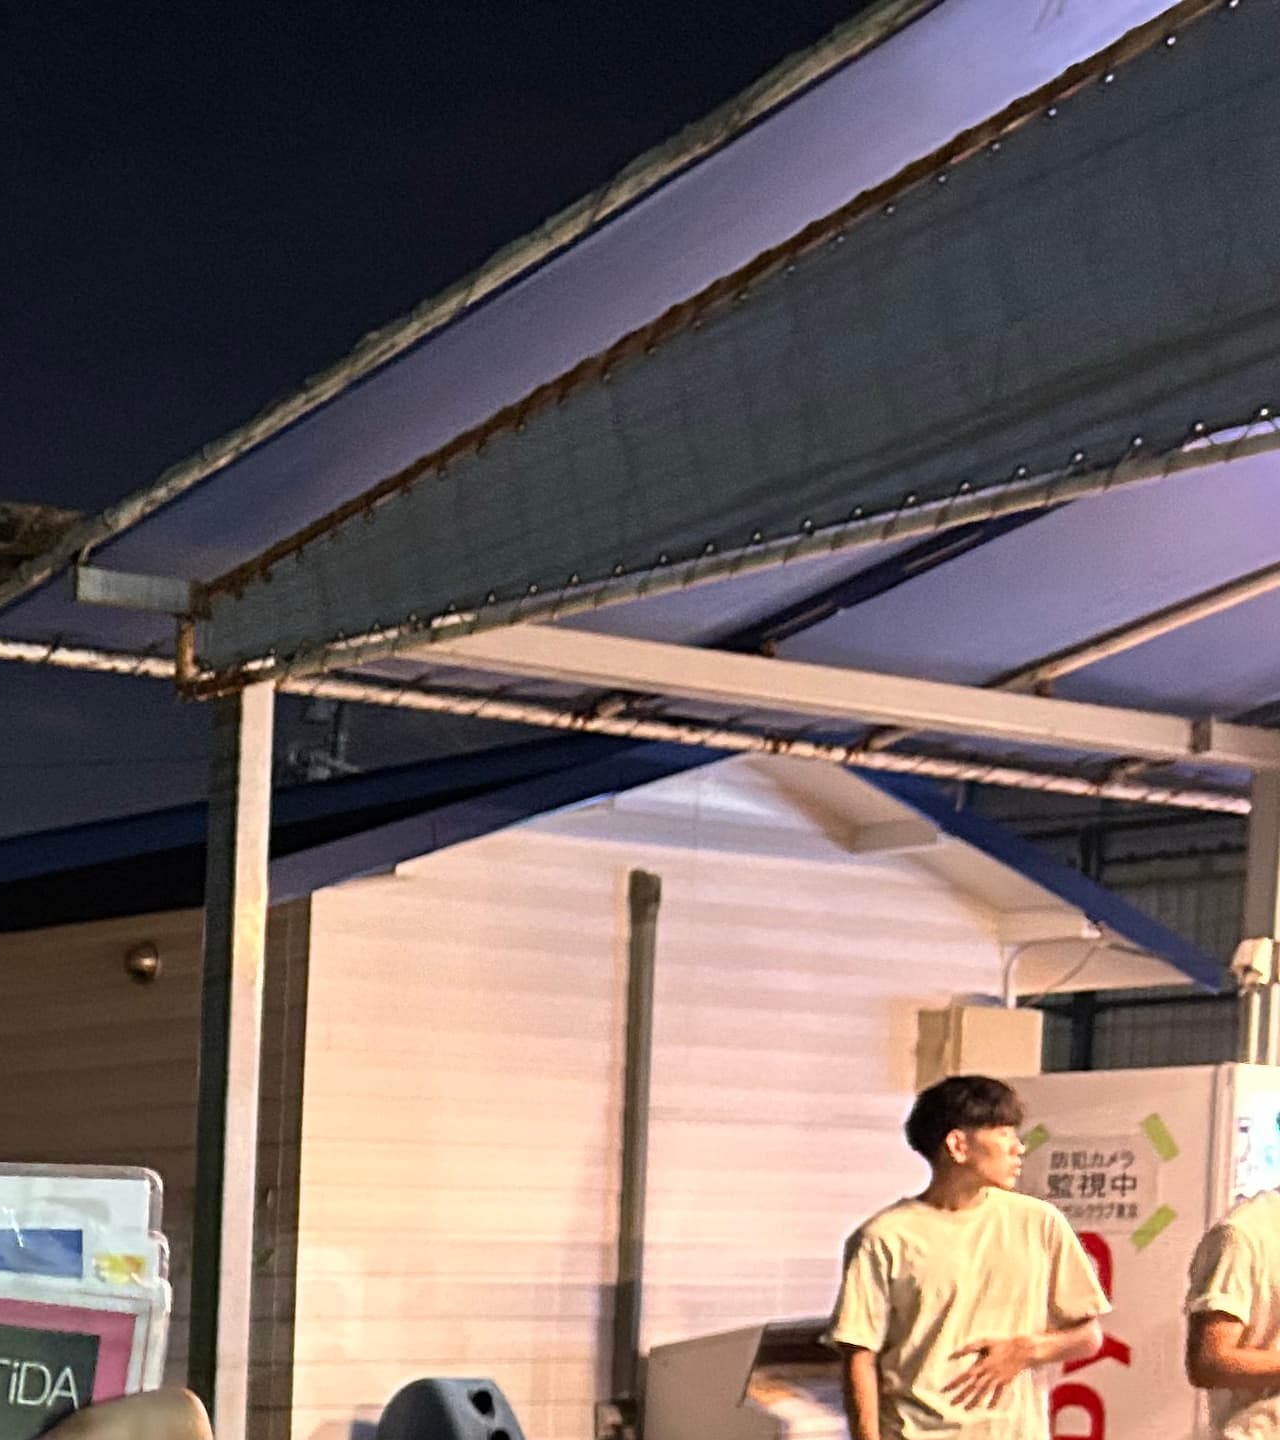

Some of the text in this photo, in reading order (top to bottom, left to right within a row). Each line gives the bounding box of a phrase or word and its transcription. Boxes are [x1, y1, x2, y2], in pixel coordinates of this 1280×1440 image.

[1050, 1150, 1136, 1171] 防犯カメラ
[1047, 1172, 1138, 1199] 監視中
